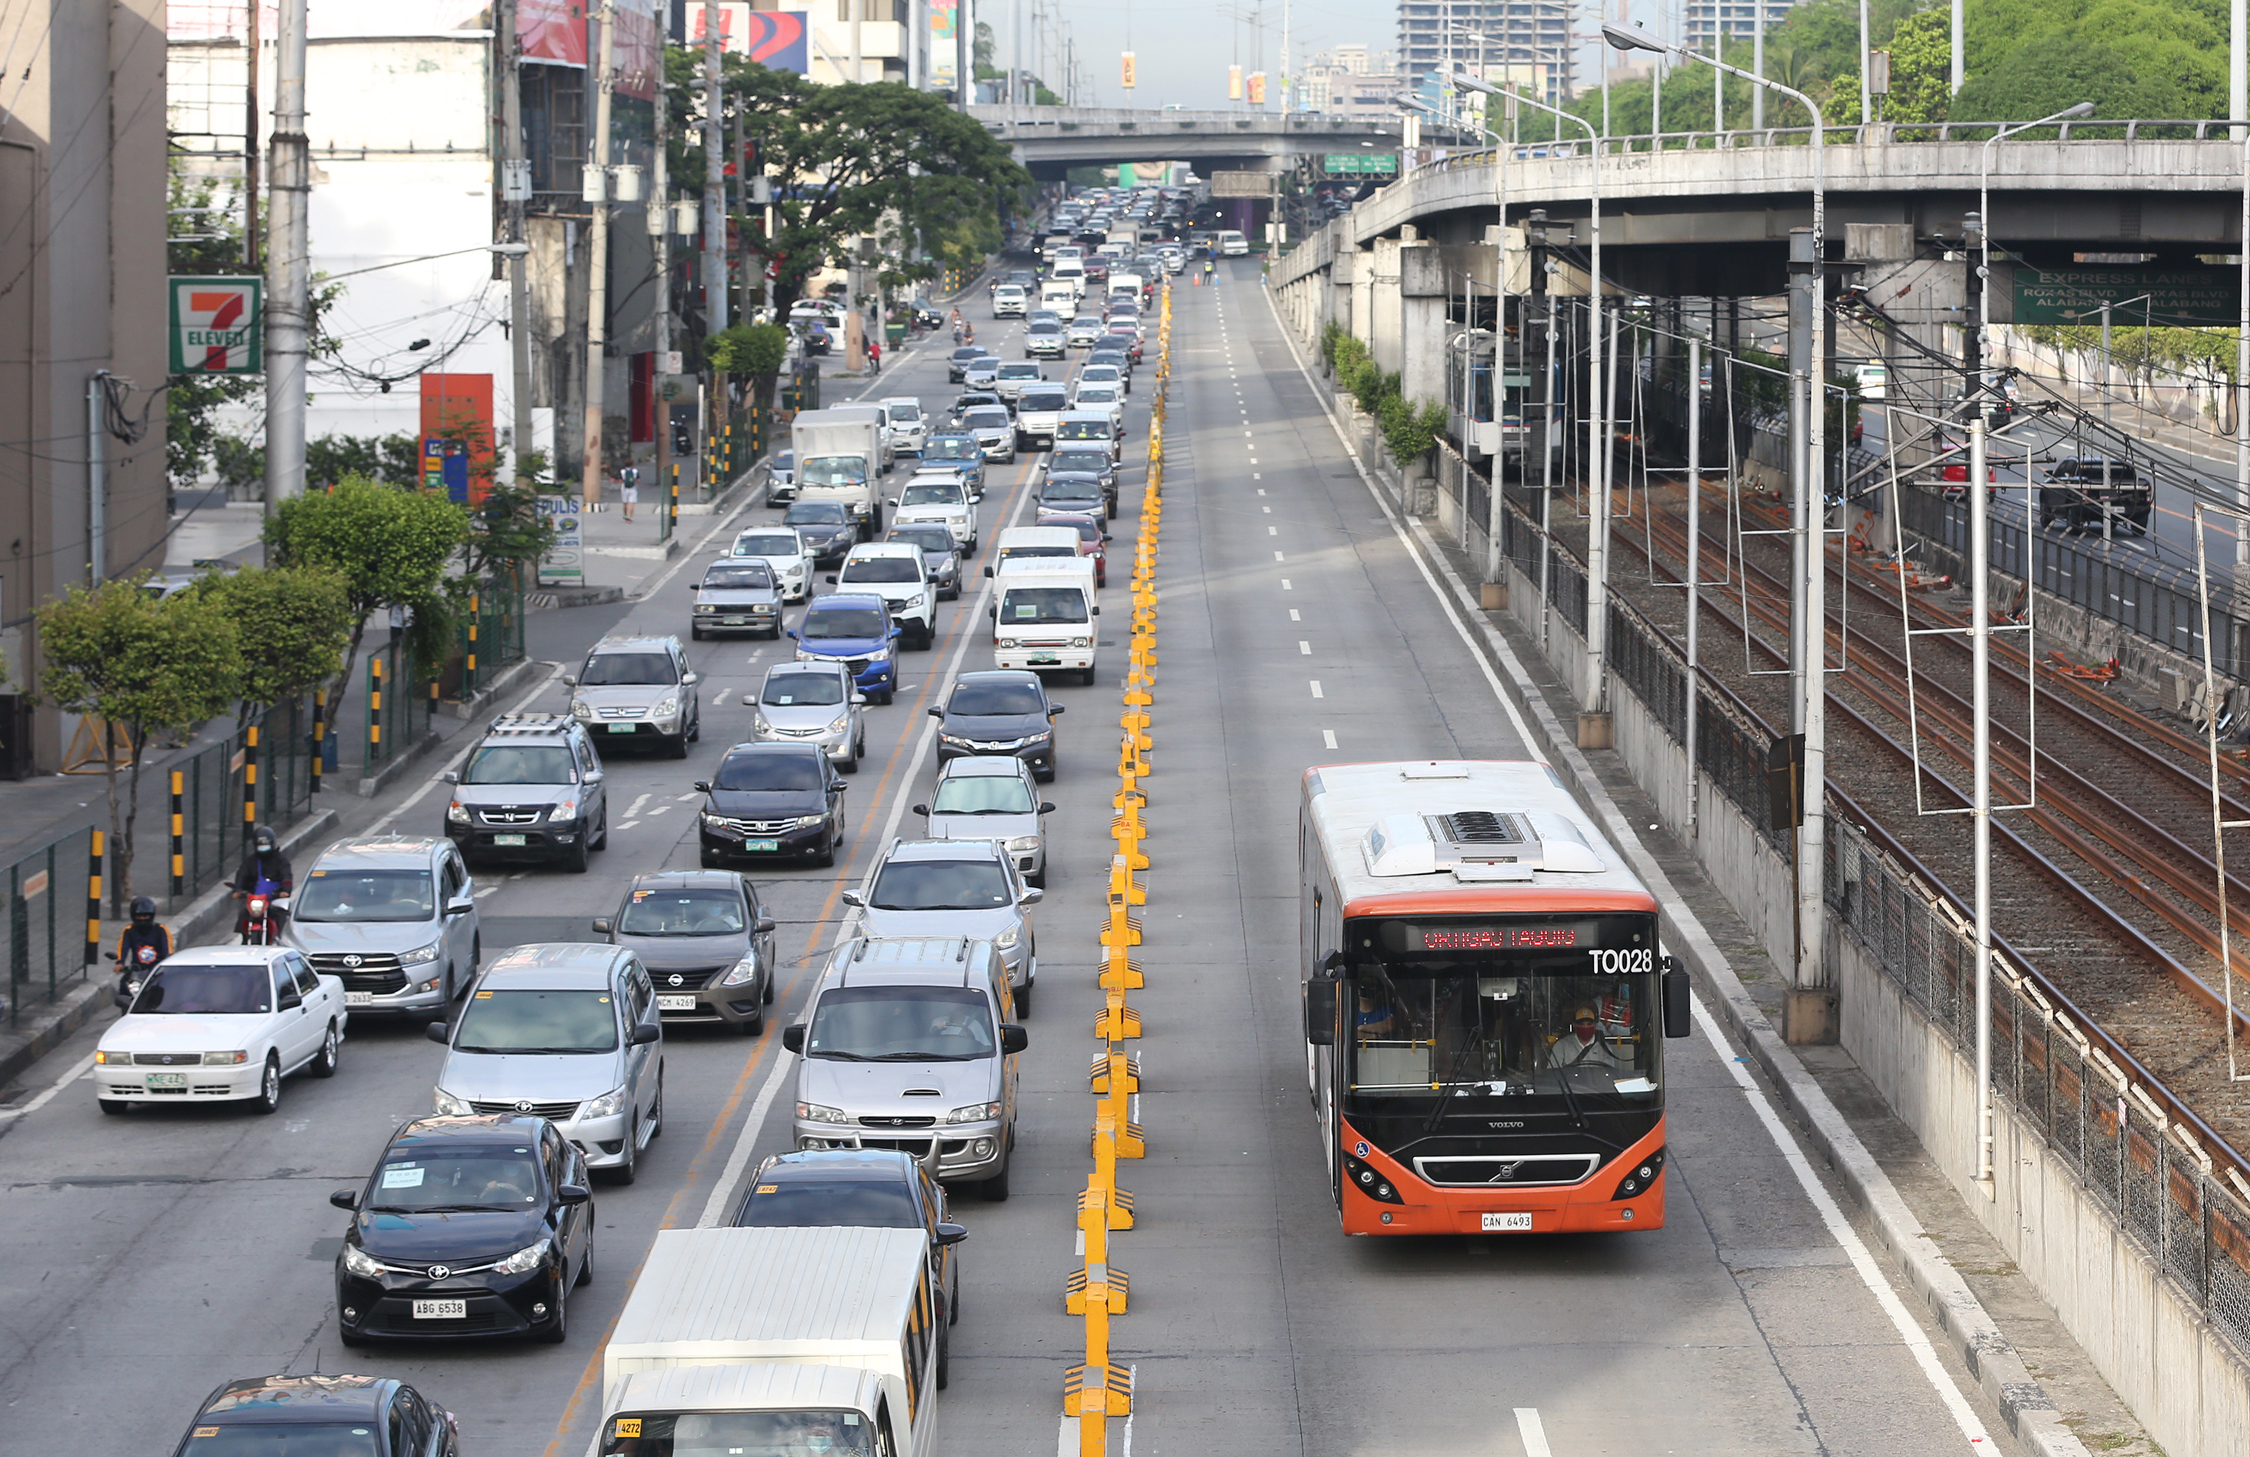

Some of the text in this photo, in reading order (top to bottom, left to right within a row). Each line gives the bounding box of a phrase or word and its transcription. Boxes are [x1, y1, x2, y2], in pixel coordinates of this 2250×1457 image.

[2039, 272, 2213, 285] EXPRESS LANES
[2023, 288, 2119, 298] ROXAS BLVD.
[2137, 289, 2230, 299] ROXAS BLVD.
[2150, 299, 2221, 308] ALABANG
[191, 292, 244, 370] 7
[676, 998, 694, 1007] 4269
[1483, 1216, 1530, 1227] CAN 6493
[416, 1302, 463, 1314] ABG 6538
[621, 1423, 640, 1434] 4272
